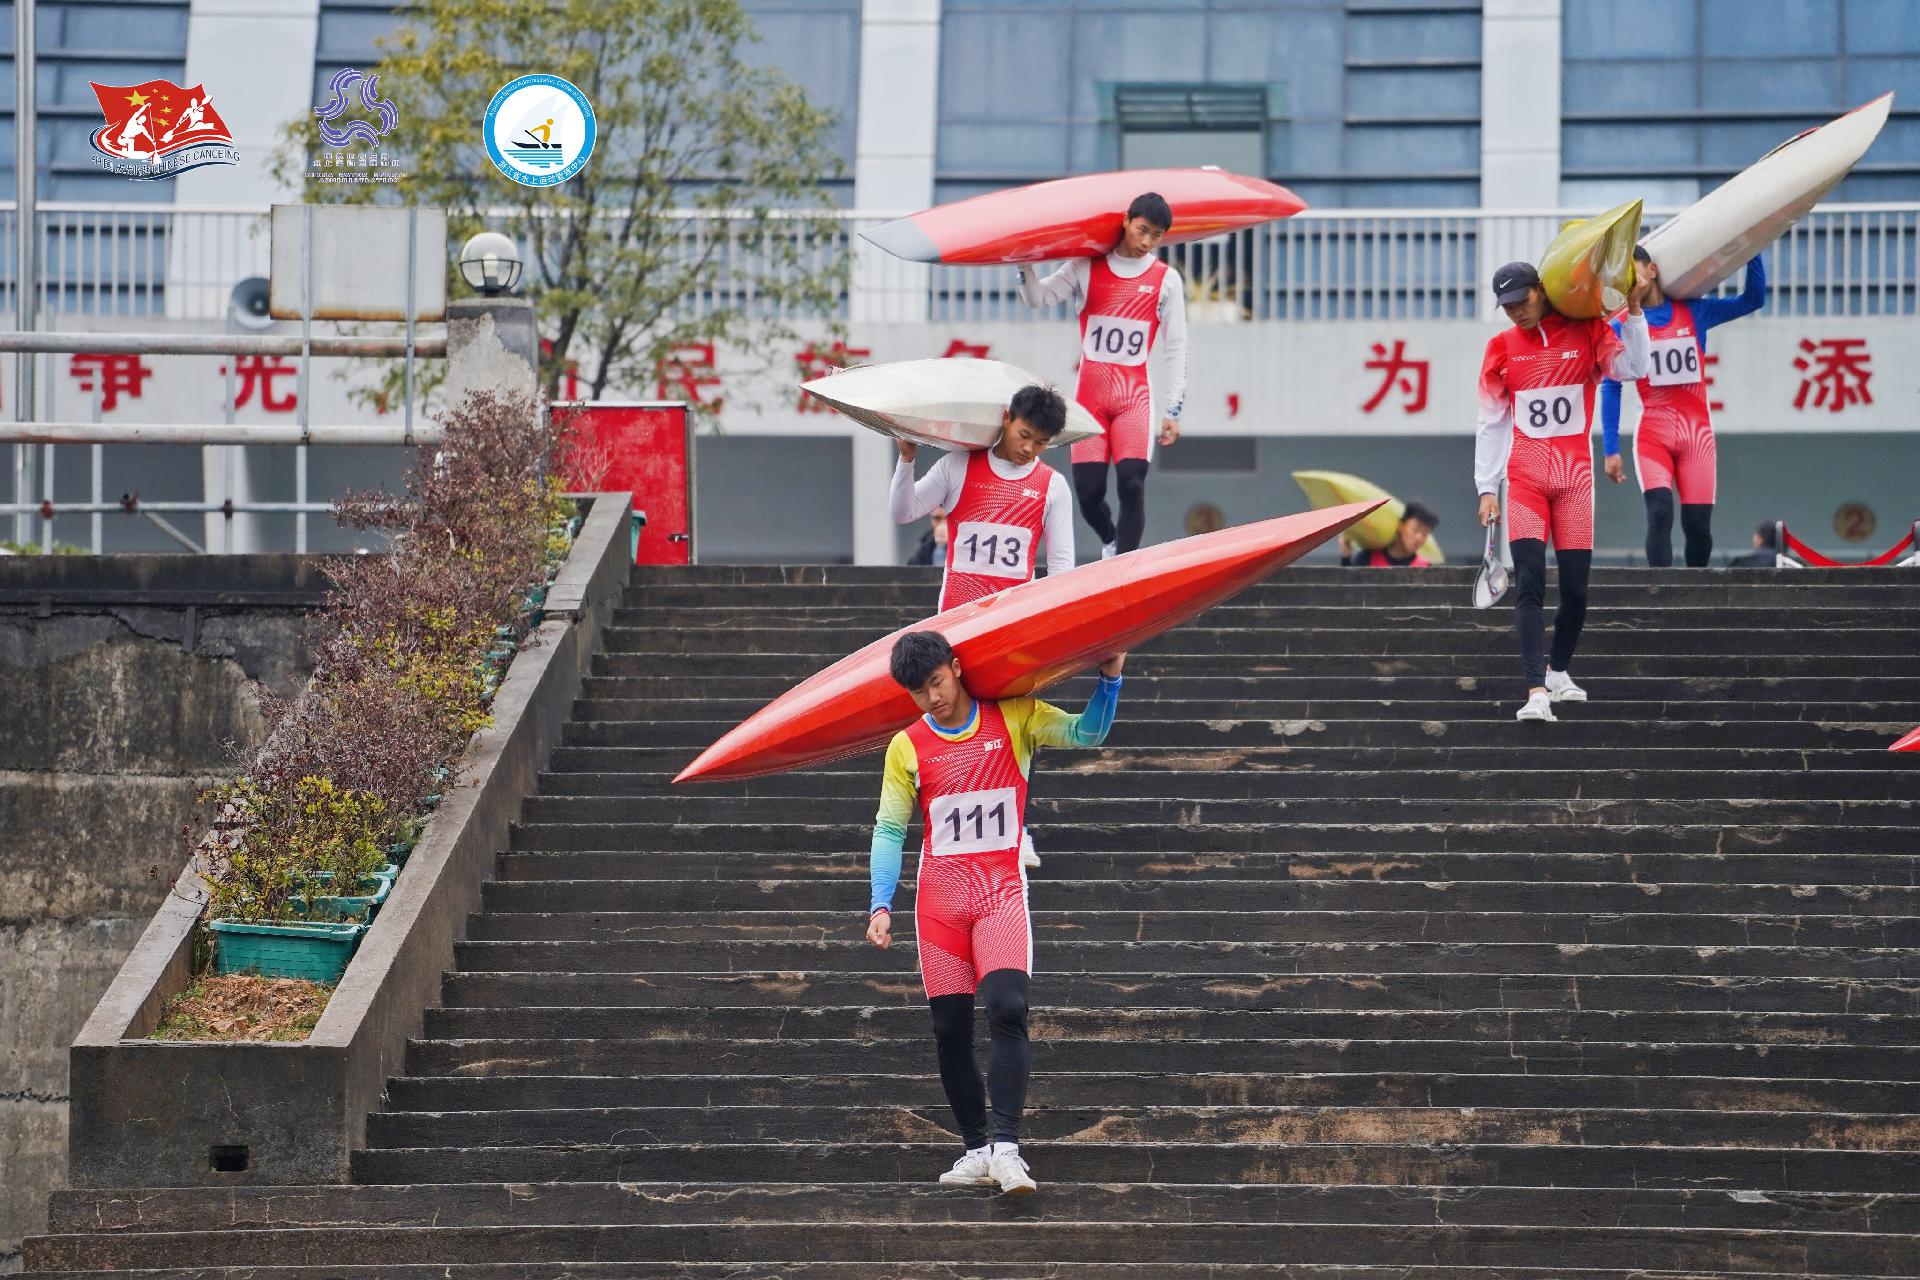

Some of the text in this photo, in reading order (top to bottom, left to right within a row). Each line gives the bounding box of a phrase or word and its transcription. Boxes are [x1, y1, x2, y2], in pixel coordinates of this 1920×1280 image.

[1091, 326, 1144, 356] 109
[1650, 346, 1697, 376] 106
[1528, 396, 1572, 428] 80
[963, 533, 1021, 567] 113
[945, 802, 1005, 841] 111
